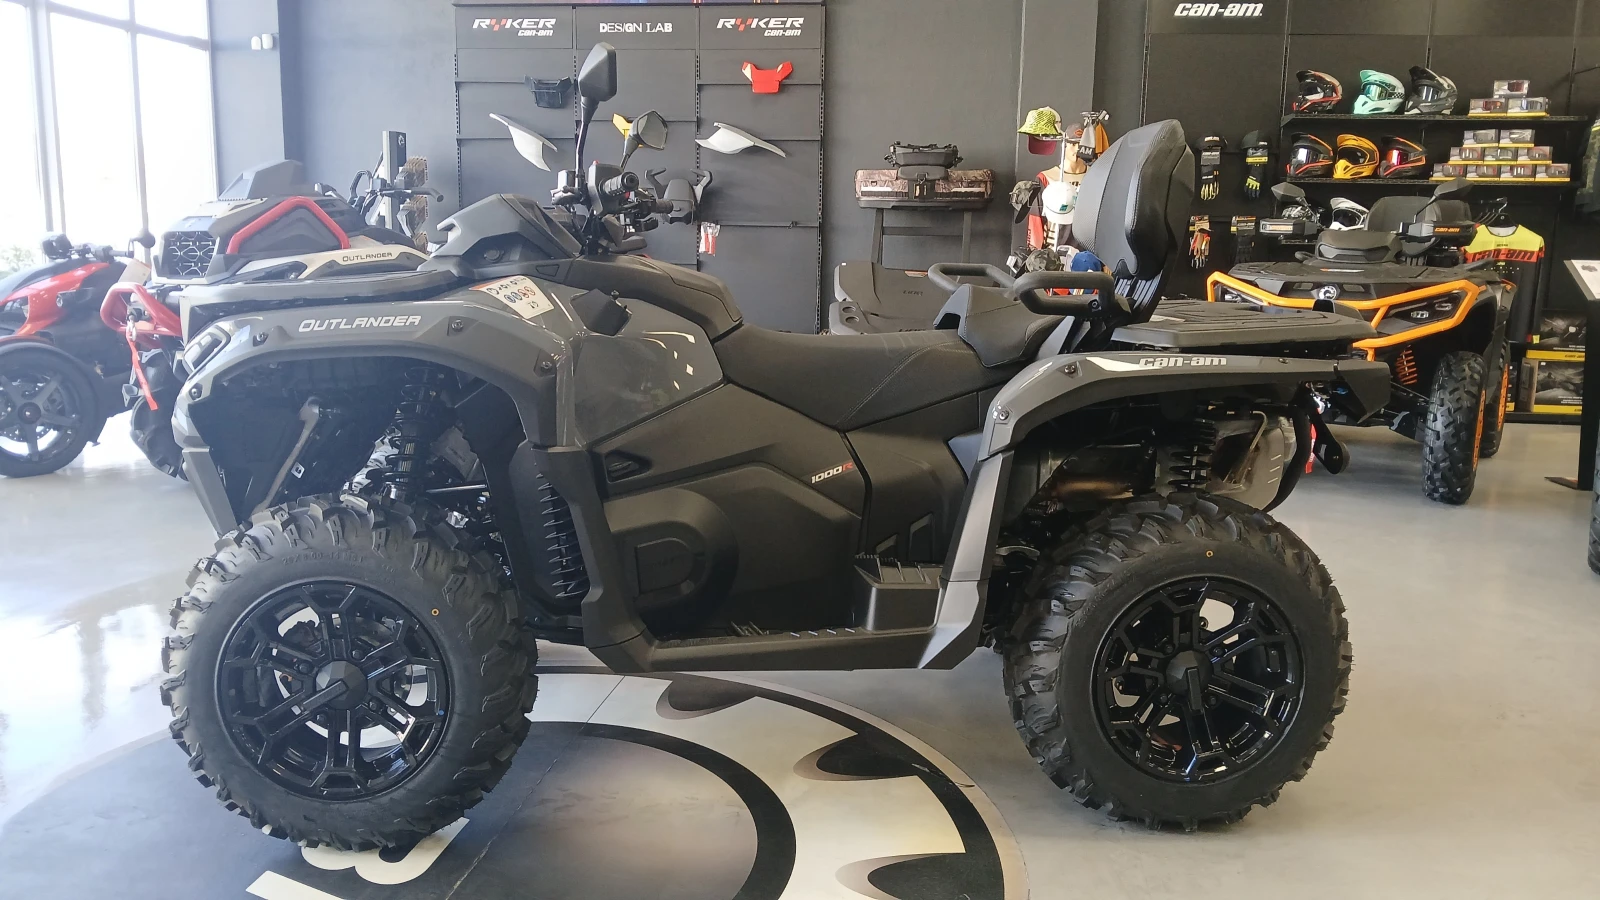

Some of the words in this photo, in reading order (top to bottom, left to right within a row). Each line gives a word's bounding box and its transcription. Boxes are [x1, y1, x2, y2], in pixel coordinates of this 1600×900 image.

[472, 18, 557, 31] RYKER
[599, 22, 643, 33] DESIGN
[645, 22, 673, 33] LAB
[716, 17, 804, 31] RYKER
[517, 29, 554, 37] can-am
[764, 29, 802, 37] can-am
[342, 252, 393, 262] OUTLANDER
[298, 315, 421, 332] OUTLANDER
[1139, 356, 1227, 369] can-am
[811, 461, 854, 484] 1000R
